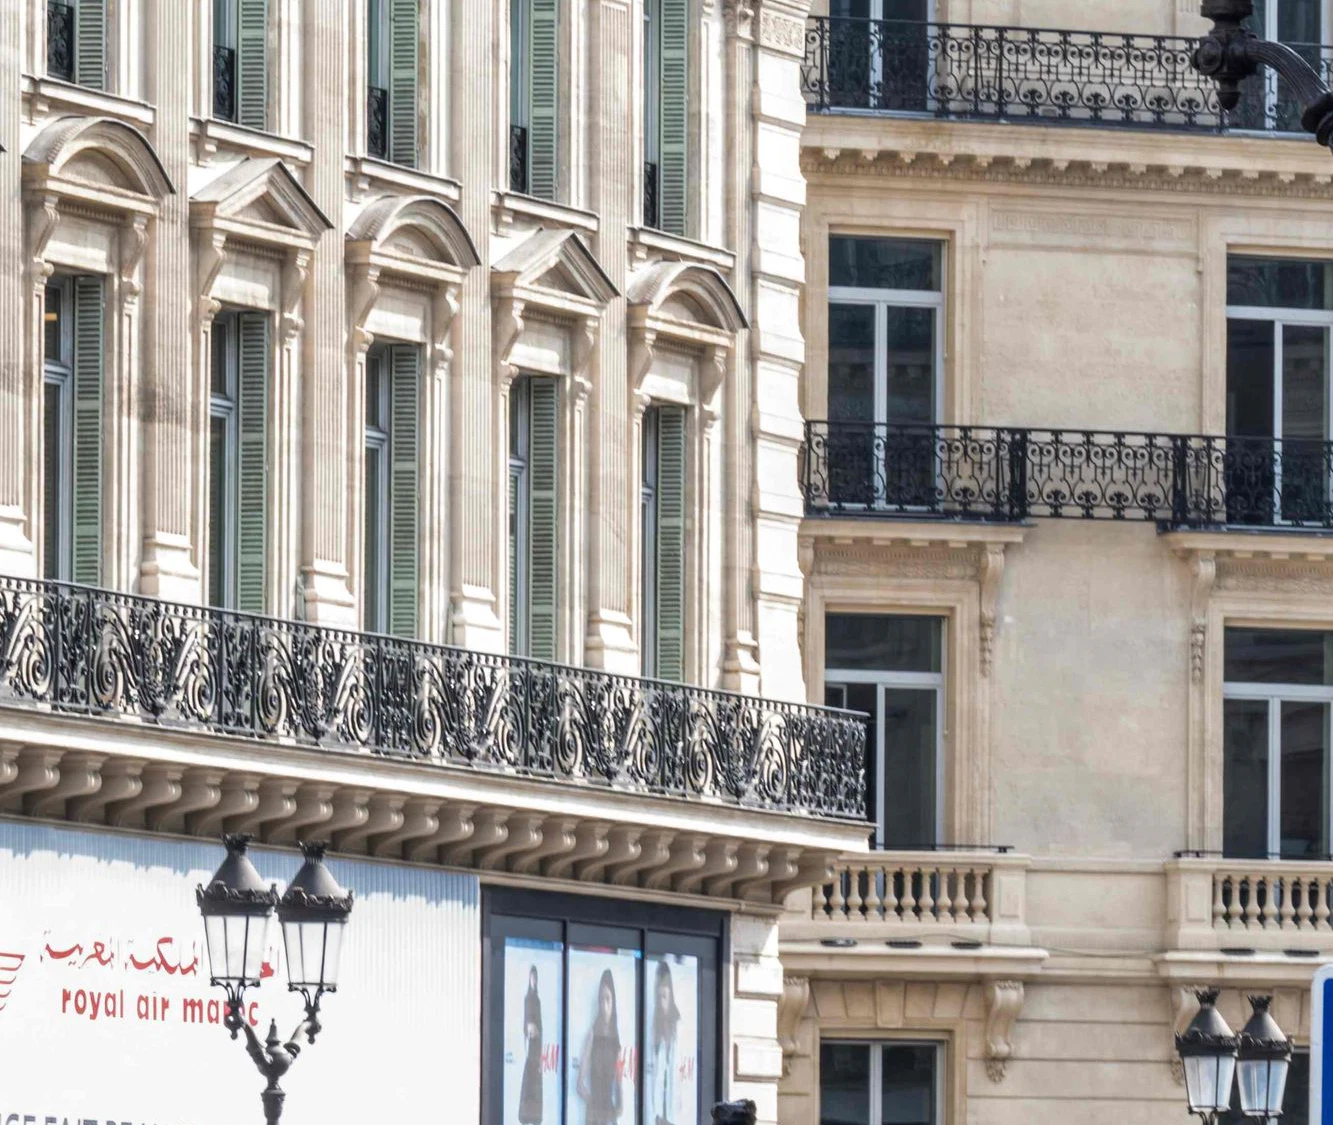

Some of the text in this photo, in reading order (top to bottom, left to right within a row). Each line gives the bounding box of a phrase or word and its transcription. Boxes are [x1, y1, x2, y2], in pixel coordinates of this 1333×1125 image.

[61, 987, 259, 1026] royal air marc
